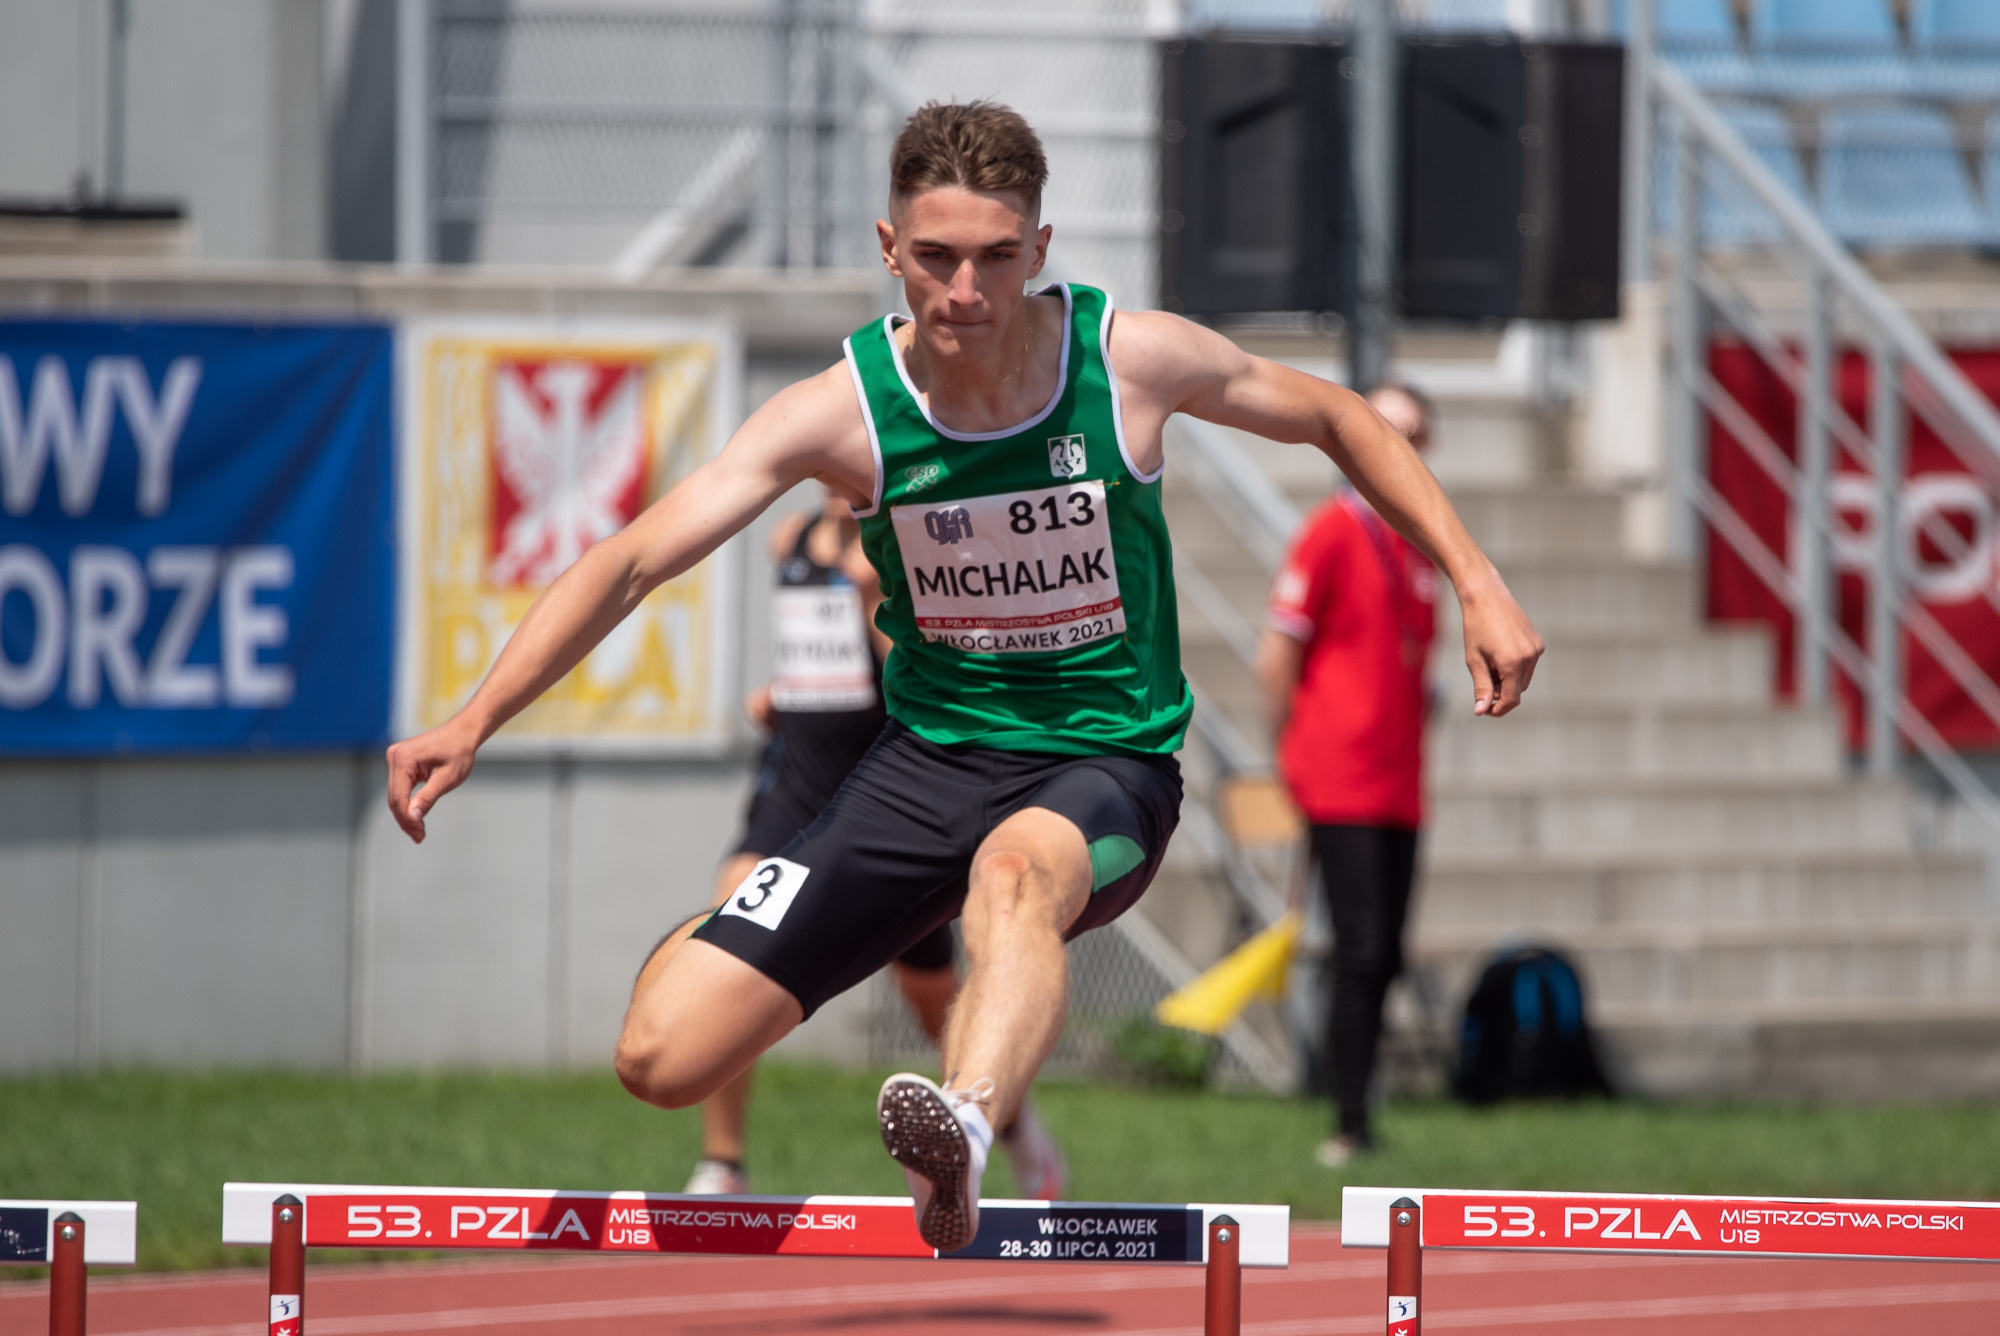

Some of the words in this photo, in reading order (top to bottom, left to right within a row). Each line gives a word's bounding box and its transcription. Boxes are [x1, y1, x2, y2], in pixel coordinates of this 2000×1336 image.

[0, 353, 204, 518] WY
[1008, 491, 1095, 535] 813
[913, 547, 1110, 598] MICHALAK
[0, 543, 296, 712] ORZE
[945, 619, 973, 628] PZLA
[1054, 607, 1092, 622] POLSKI
[1094, 602, 1114, 613] U18
[1068, 618, 1114, 643] 2021
[737, 864, 783, 912] 3
[347, 1205, 433, 1238] 53.
[450, 1205, 591, 1241] PZLA
[608, 1208, 773, 1229] MISTRZOSTWA
[777, 1213, 856, 1230] POLSKI
[608, 1229, 650, 1245] U18
[1037, 1217, 1158, 1236] WŁOCŁAWEK
[1464, 1205, 1546, 1238] 53.
[1564, 1206, 1702, 1241] PZLA
[1719, 1208, 1882, 1229] MISTRZOSTWA
[1886, 1213, 1964, 1231] POLSKI
[1719, 1228, 1760, 1244] U18
[999, 1240, 1052, 1257] 28-30
[1056, 1241, 1110, 1258] LIPCA
[1114, 1241, 1156, 1258] 2021
